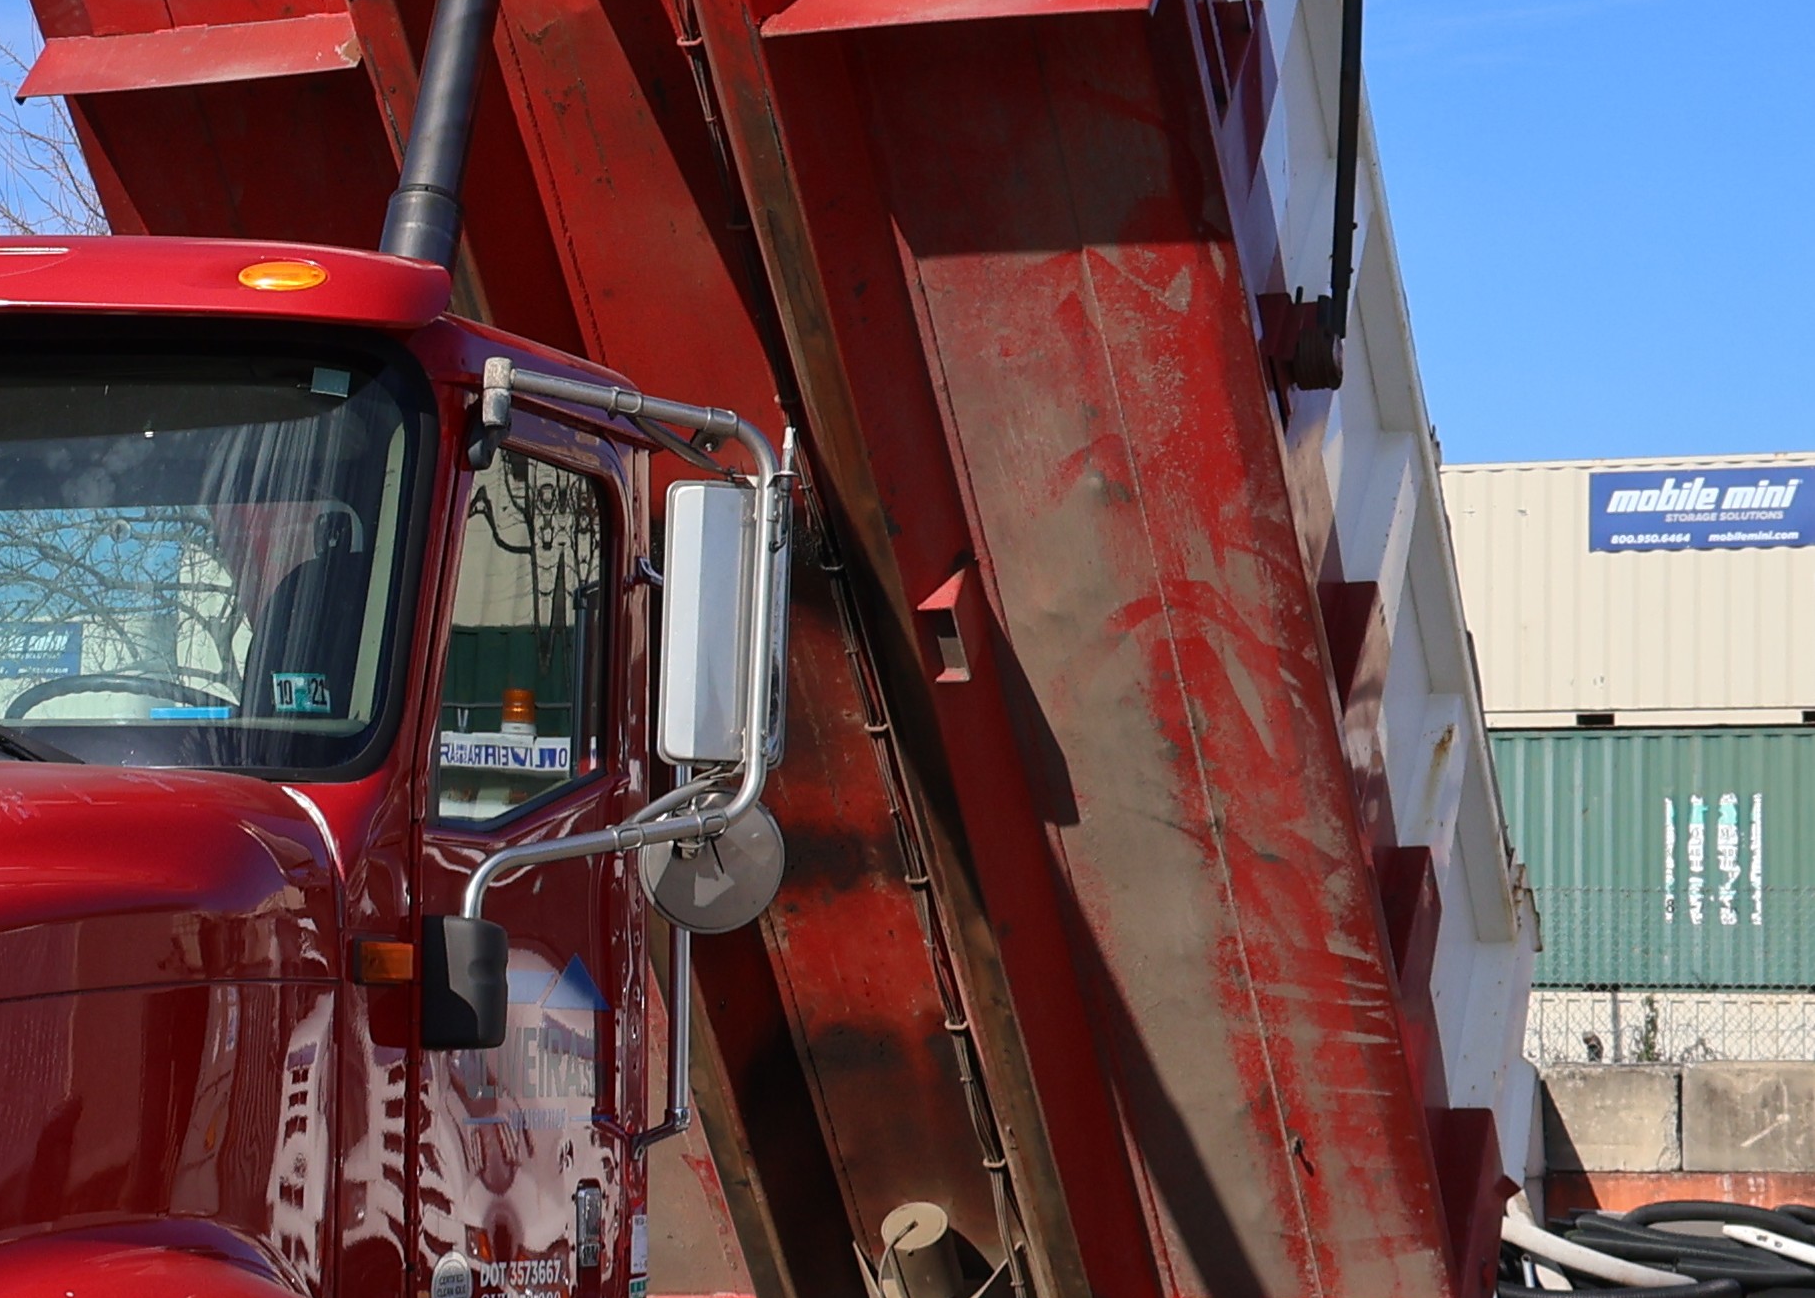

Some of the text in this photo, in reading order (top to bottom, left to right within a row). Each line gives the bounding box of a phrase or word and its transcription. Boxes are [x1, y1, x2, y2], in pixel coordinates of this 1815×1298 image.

[1606, 477, 1800, 514] mobile mini
[1664, 510, 1784, 523] STORAGE SOLUTIONS
[1610, 530, 1799, 545] 800.950.6464 mobilemini.com
[480, 1259, 561, 1288] DOT 3573667
